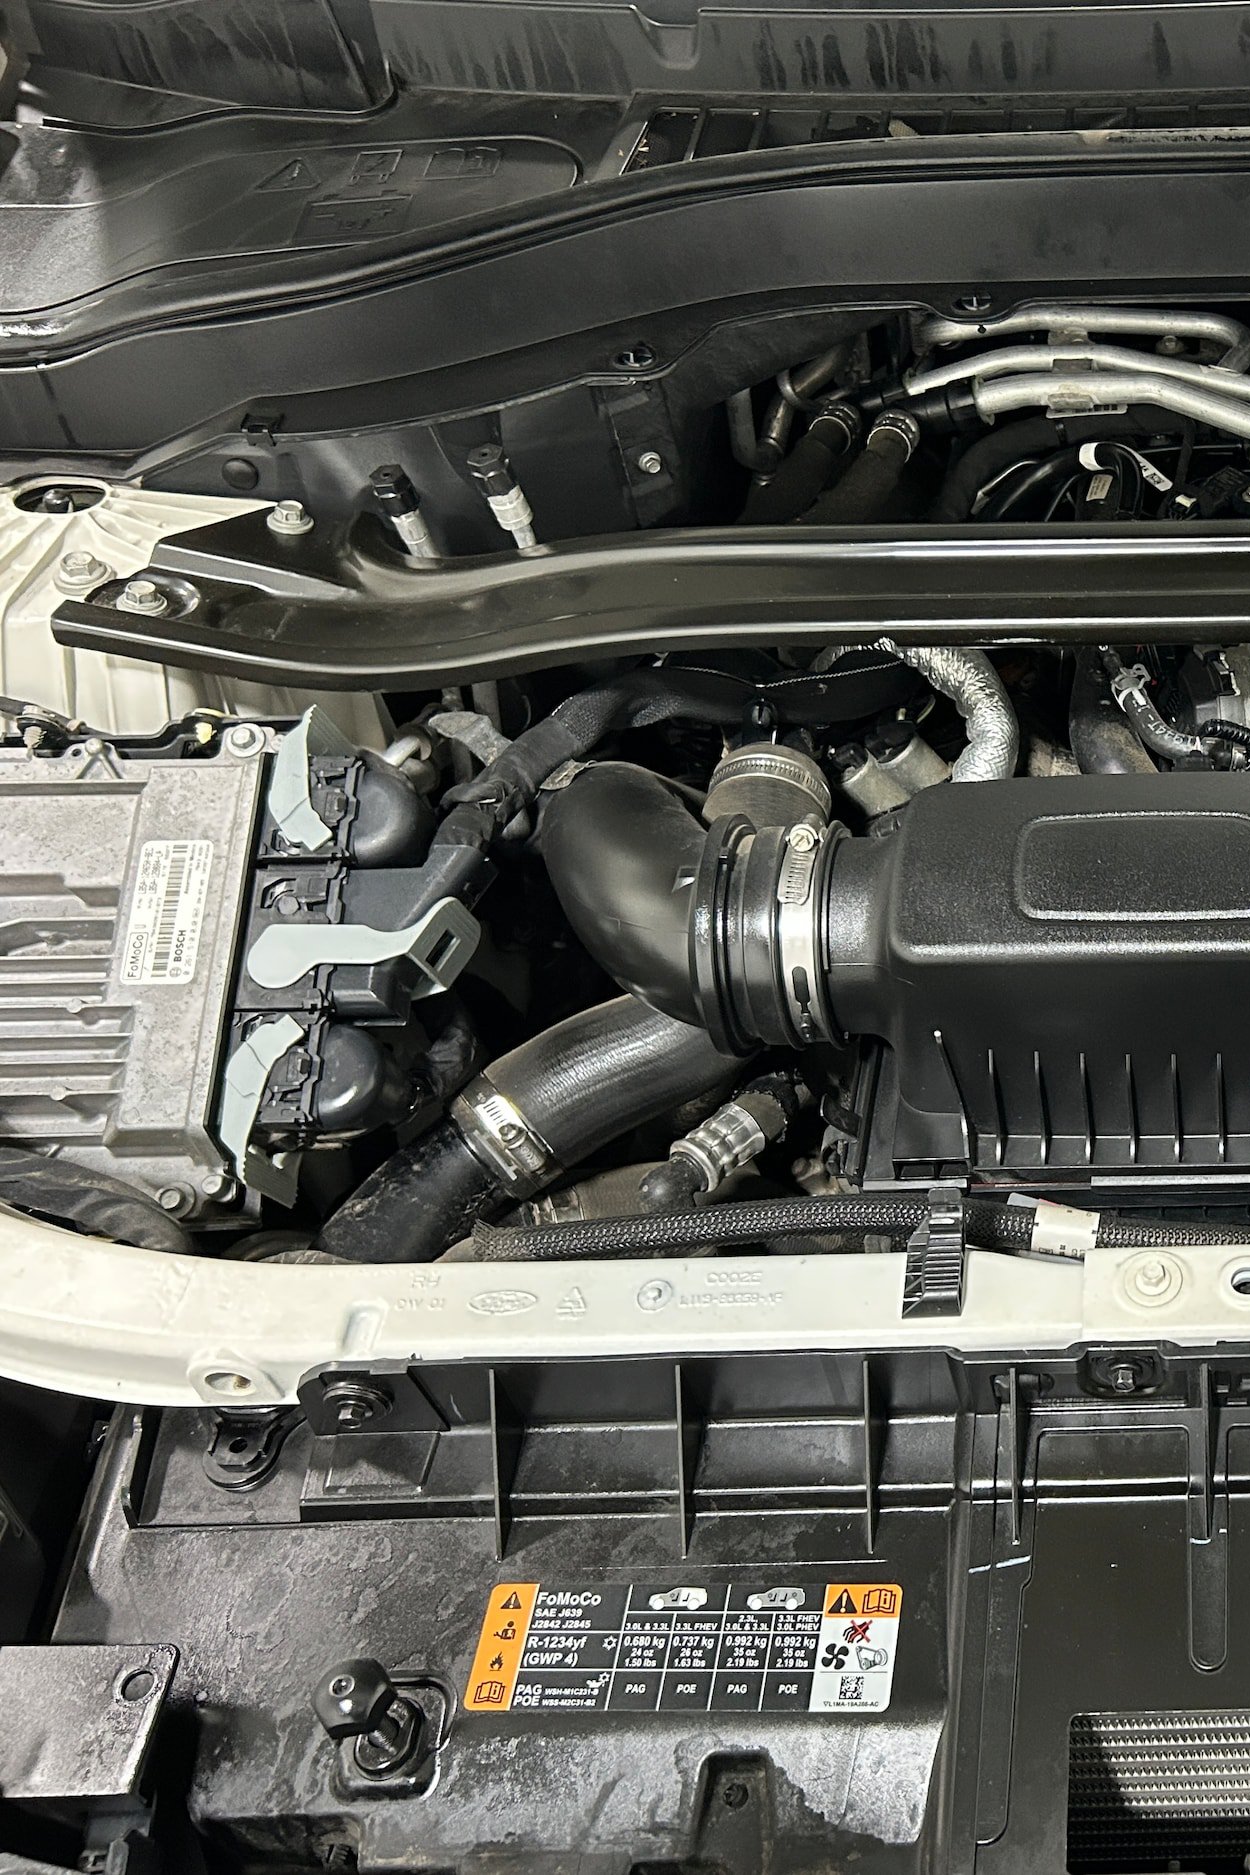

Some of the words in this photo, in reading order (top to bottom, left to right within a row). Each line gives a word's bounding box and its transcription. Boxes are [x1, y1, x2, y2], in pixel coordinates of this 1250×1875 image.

[174, 929, 187, 962] BOSCH
[128, 934, 144, 978] FoMoCo
[537, 1592, 602, 1606] FoMoCo
[534, 1608, 557, 1617] SAE
[558, 1608, 582, 1617] J639
[738, 1614, 758, 1623] 2.3L,
[778, 1614, 796, 1622] 3.3L
[796, 1614, 820, 1622] FHEV
[532, 1620, 561, 1628] J2842
[562, 1620, 592, 1628] J2845
[625, 1622, 642, 1630] 3.0L
[652, 1622, 670, 1630] 3.3L
[676, 1622, 692, 1630] 3.3L
[694, 1622, 718, 1630] FHEV
[527, 1636, 587, 1651] R-1234yf
[624, 1636, 651, 1646] 0.680
[652, 1636, 666, 1648] kg
[673, 1636, 700, 1646] 0.737
[701, 1636, 714, 1649] kg
[726, 1636, 752, 1646] 0.992
[754, 1636, 767, 1648] kg
[774, 1636, 802, 1647] 0.992
[803, 1636, 816, 1649] kg
[630, 1648, 642, 1656] 24
[680, 1648, 691, 1656] 26
[733, 1648, 744, 1656] 35
[782, 1648, 794, 1657] 35
[523, 1652, 562, 1667] (GWP
[564, 1652, 578, 1667] 4)
[625, 1658, 642, 1666] 1.50
[643, 1658, 656, 1666] lbs
[674, 1658, 691, 1667] 1.63
[692, 1658, 706, 1667] lbs
[726, 1658, 745, 1667] 2.19
[746, 1658, 759, 1667] lbs
[776, 1658, 794, 1668] 2.19
[795, 1659, 808, 1668] lbs
[516, 1684, 542, 1695] PAG
[625, 1684, 646, 1694] PAG
[676, 1684, 697, 1694] POE
[727, 1684, 748, 1694] PAG
[778, 1684, 798, 1694] POE
[513, 1696, 540, 1706] POE
